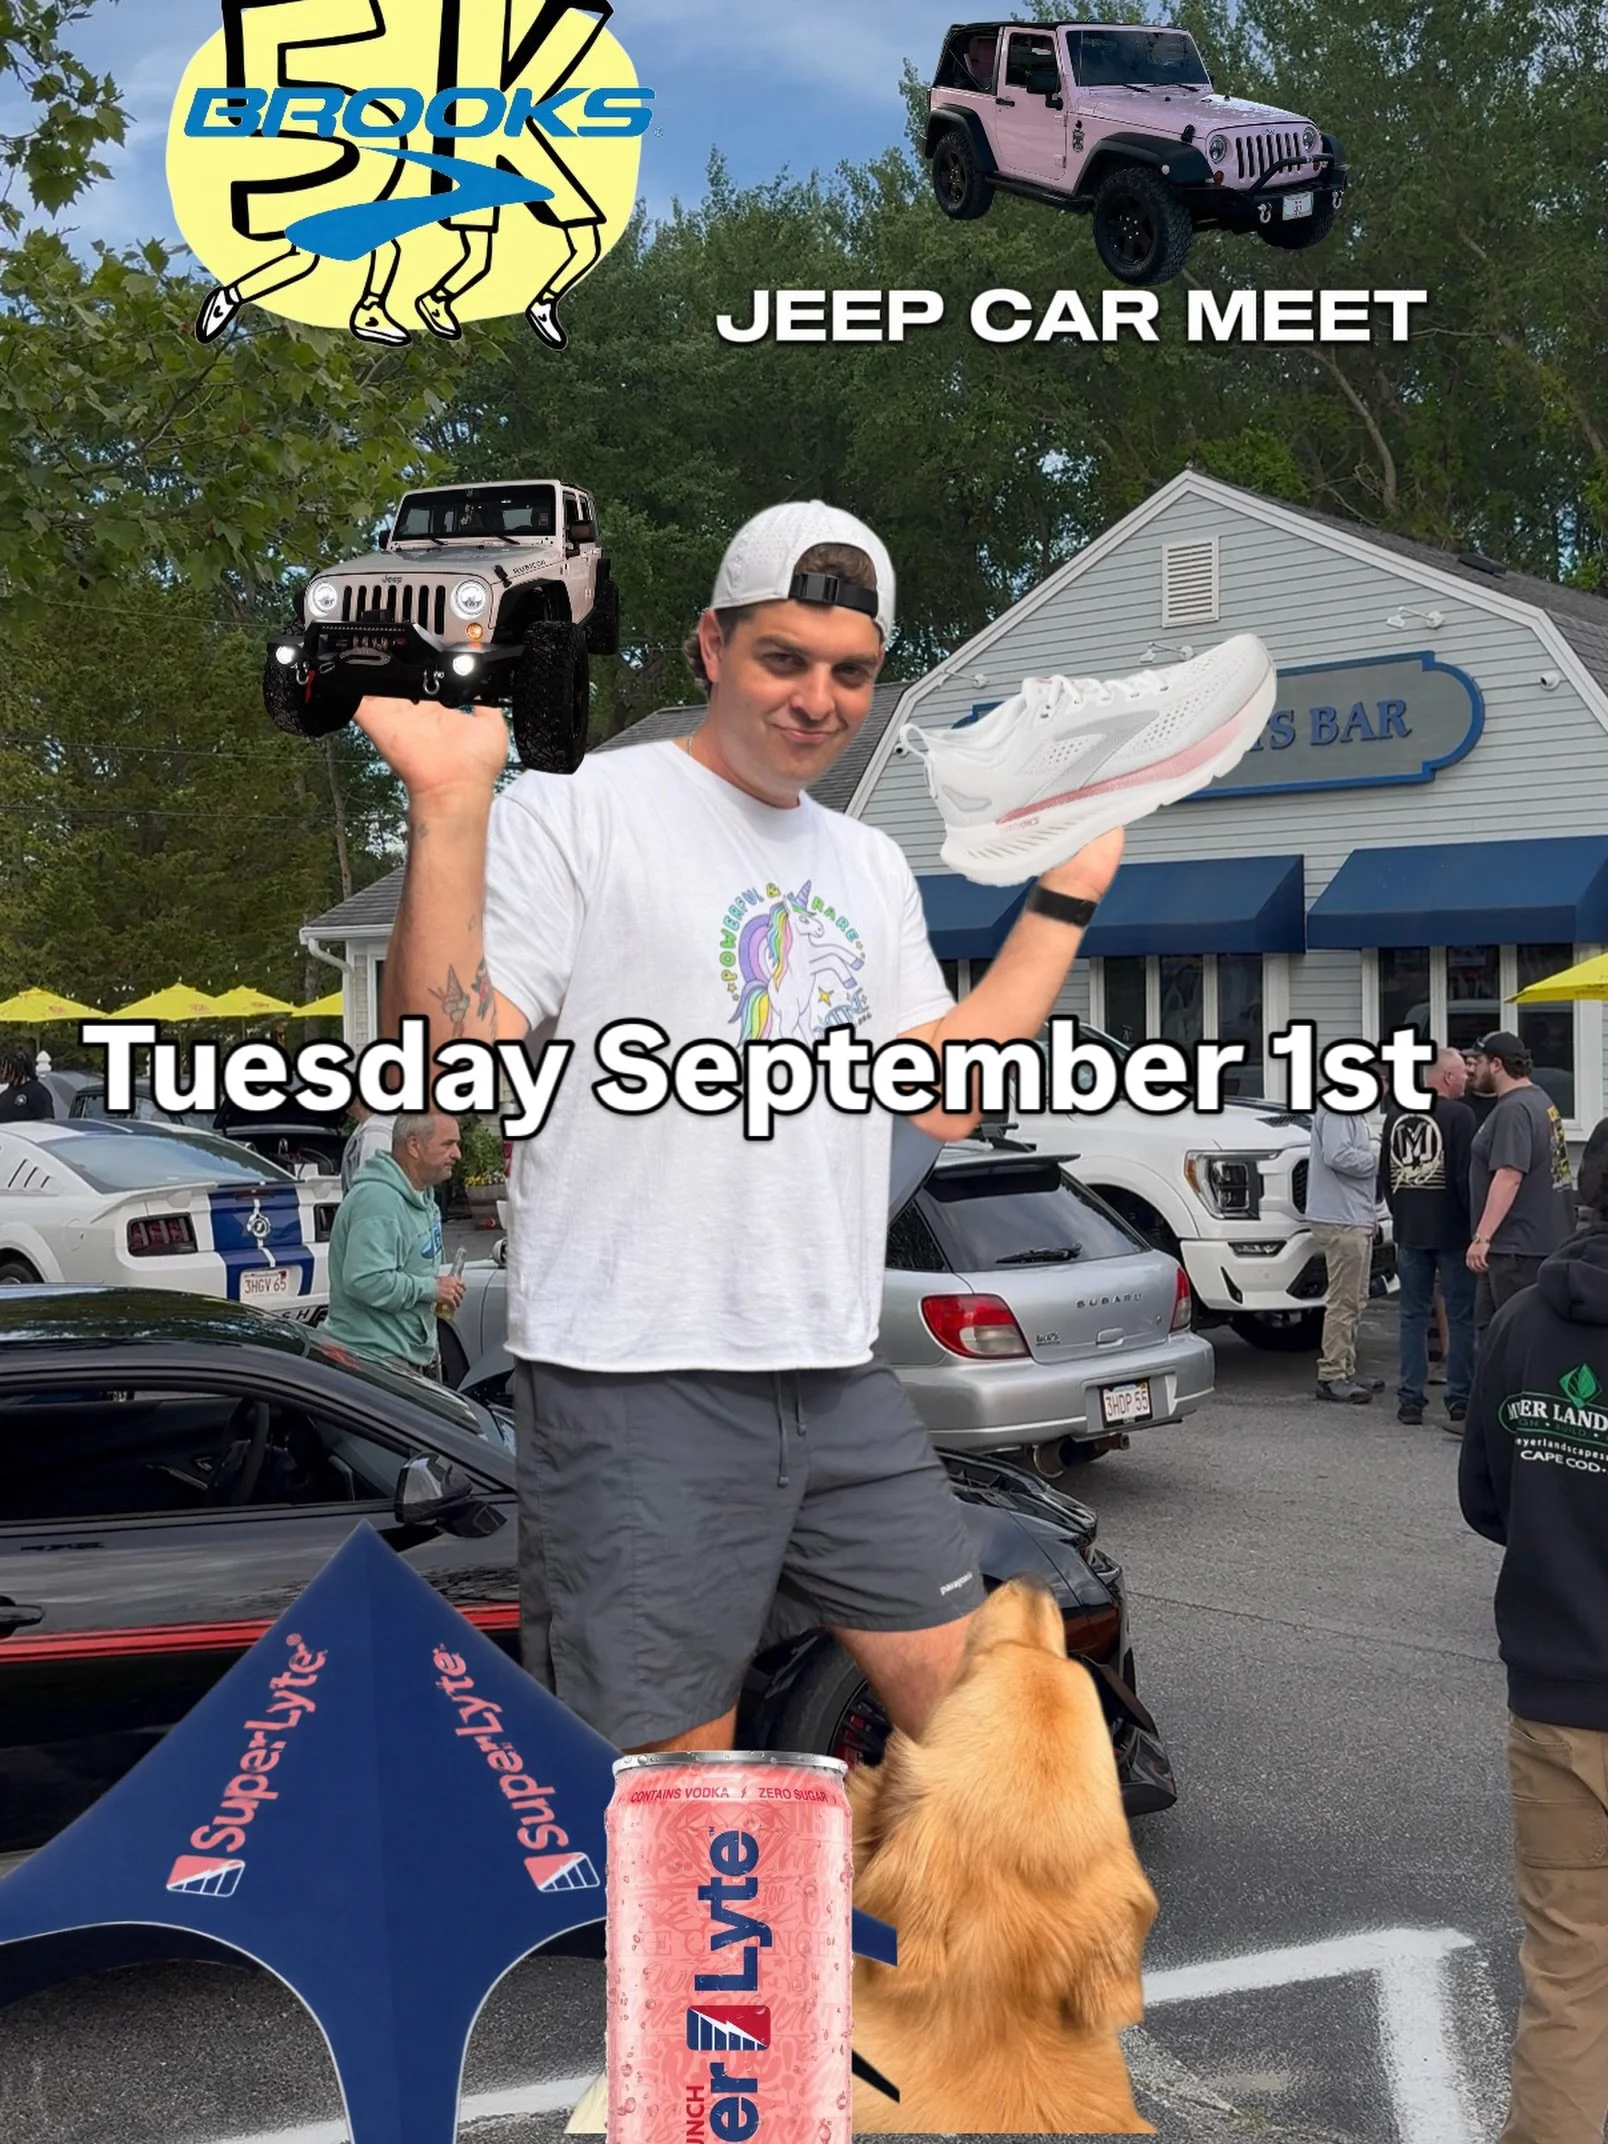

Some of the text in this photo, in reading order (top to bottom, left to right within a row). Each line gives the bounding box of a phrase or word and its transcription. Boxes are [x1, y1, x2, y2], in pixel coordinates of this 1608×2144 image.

[1308, 698, 1413, 747] BAR
[243, 1276, 287, 1294] 3HGV 65
[1076, 1292, 1142, 1309] SUBARU
[1520, 1449, 1601, 1473] CAPE COD
[631, 1787, 828, 1803] CONTAINS VODKA ZERO SUGAR
